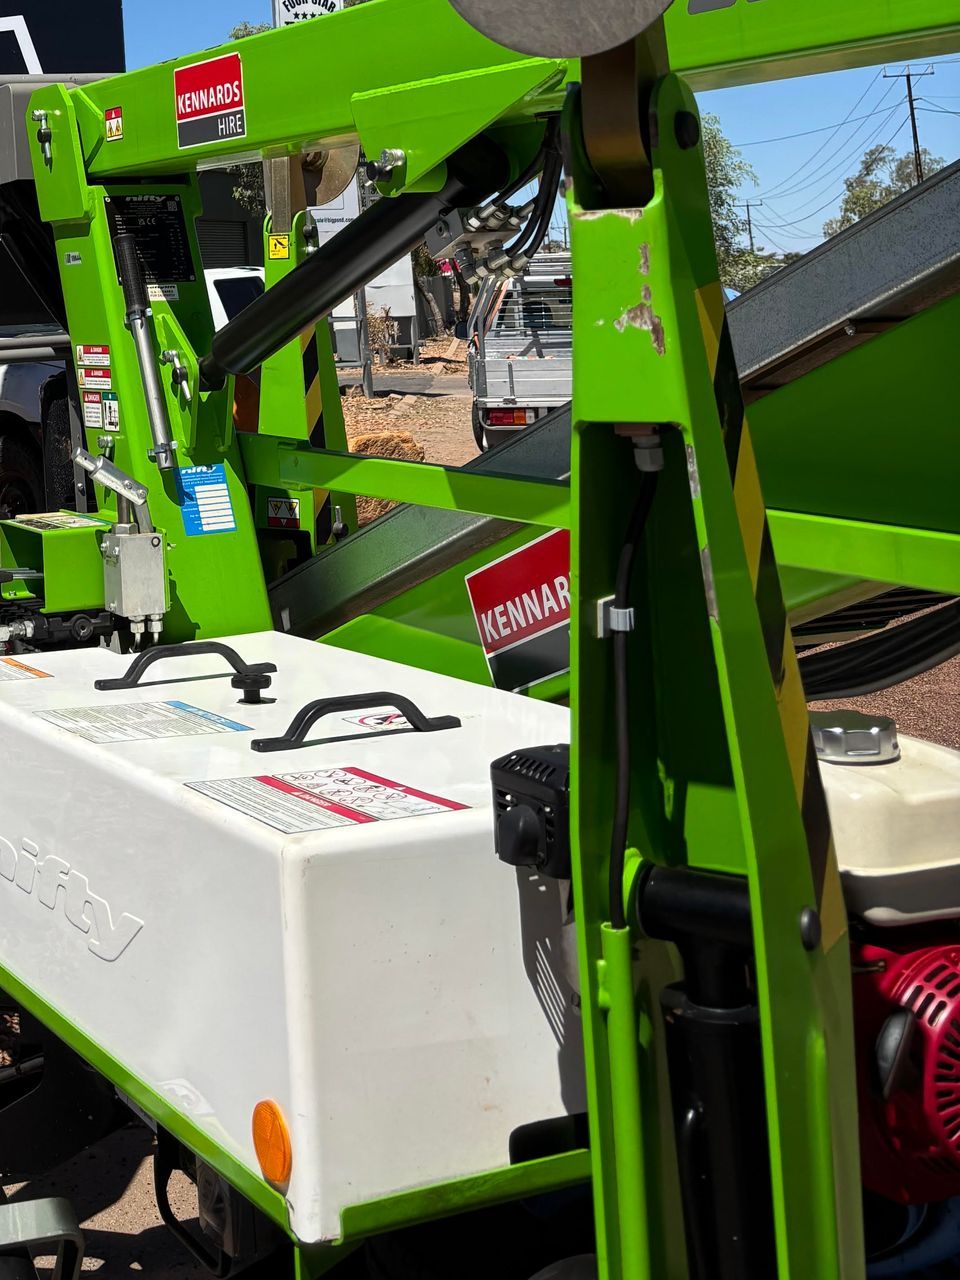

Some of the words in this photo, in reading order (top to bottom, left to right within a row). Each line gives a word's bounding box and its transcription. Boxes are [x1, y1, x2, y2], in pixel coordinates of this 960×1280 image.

[177, 80, 241, 115] KENNARDS
[217, 114, 243, 136] HIRE
[480, 571, 571, 644] KENNAR
